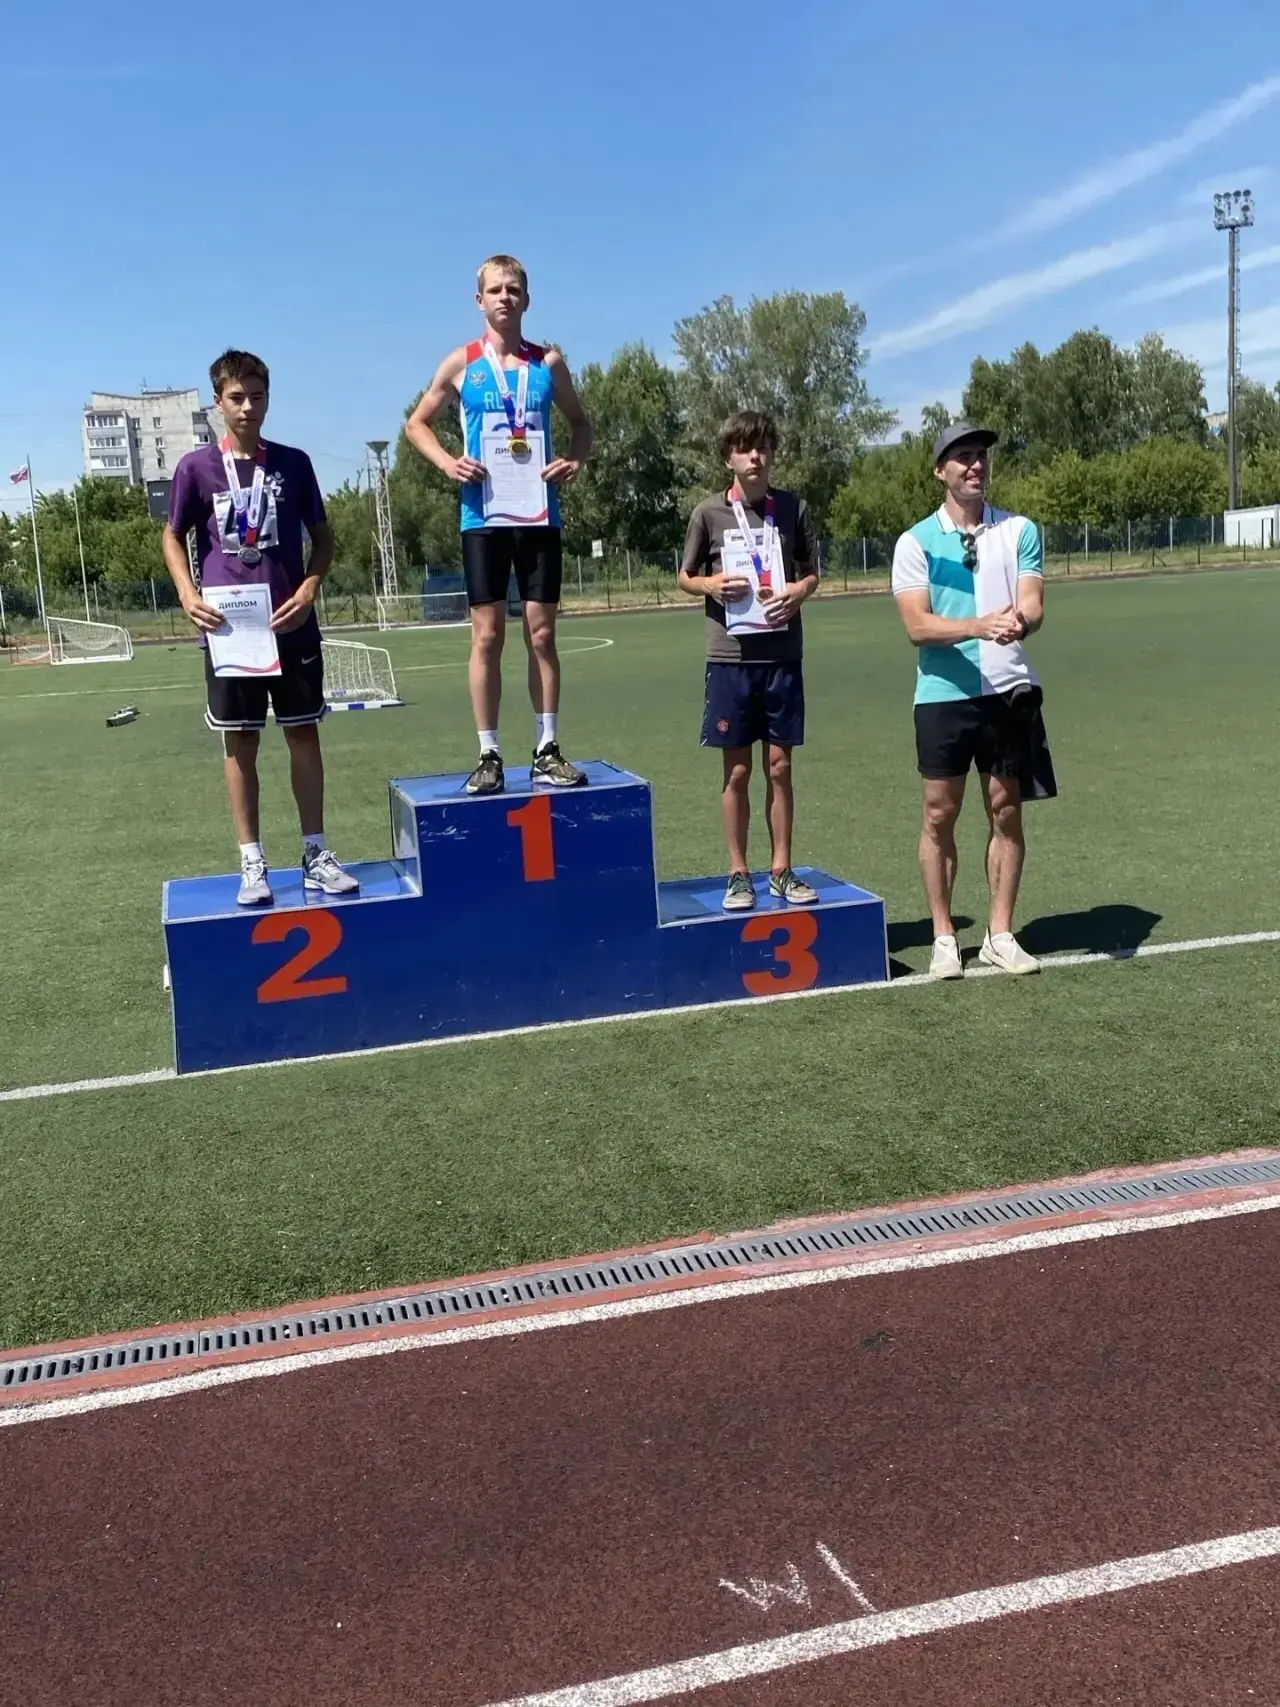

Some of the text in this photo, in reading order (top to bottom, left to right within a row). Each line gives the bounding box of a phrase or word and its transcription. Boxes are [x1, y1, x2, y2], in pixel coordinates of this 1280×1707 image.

[218, 600, 258, 609] ДИПЛОМ
[507, 795, 556, 883] 1
[251, 909, 348, 1004] 2
[741, 912, 820, 996] 3
